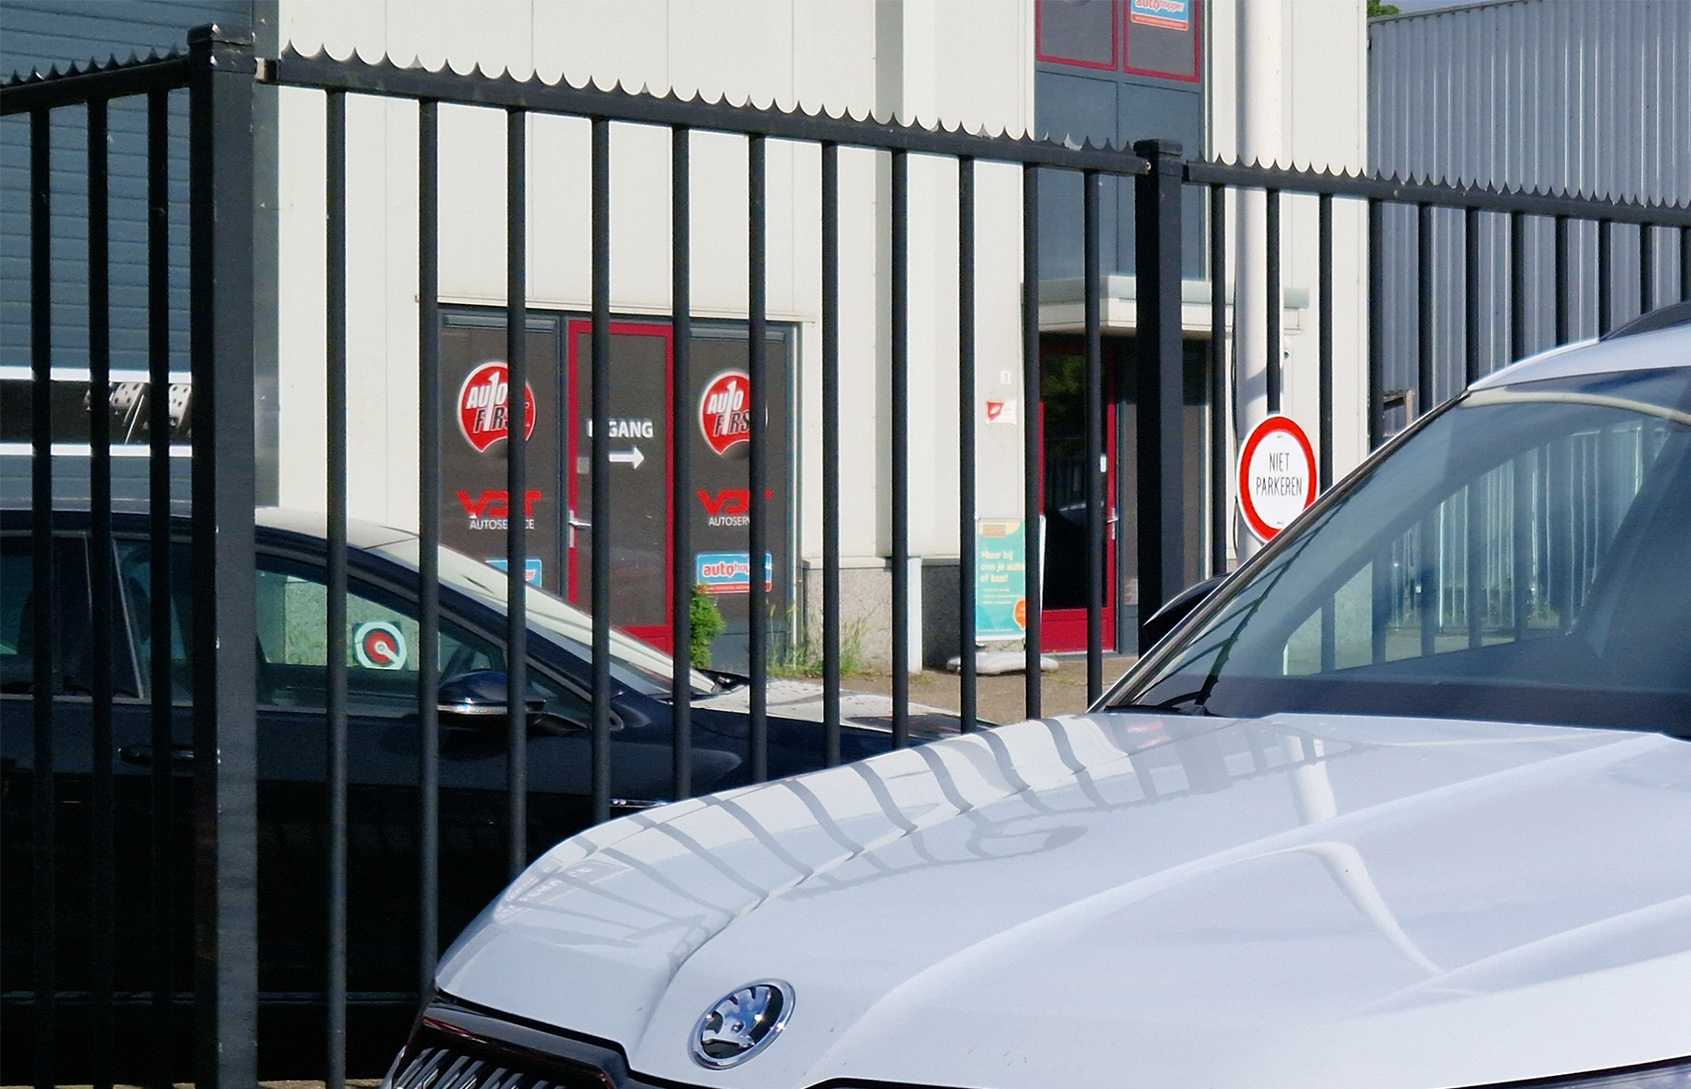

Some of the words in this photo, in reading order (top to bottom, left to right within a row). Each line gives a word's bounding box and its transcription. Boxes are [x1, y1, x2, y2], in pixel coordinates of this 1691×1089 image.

[588, 419, 653, 438] IGANG
[1269, 453, 1290, 472] NIET
[1256, 476, 1302, 496] PARKEREN
[469, 519, 534, 530] AUTOSEE
[709, 516, 750, 527] AUTOSER
